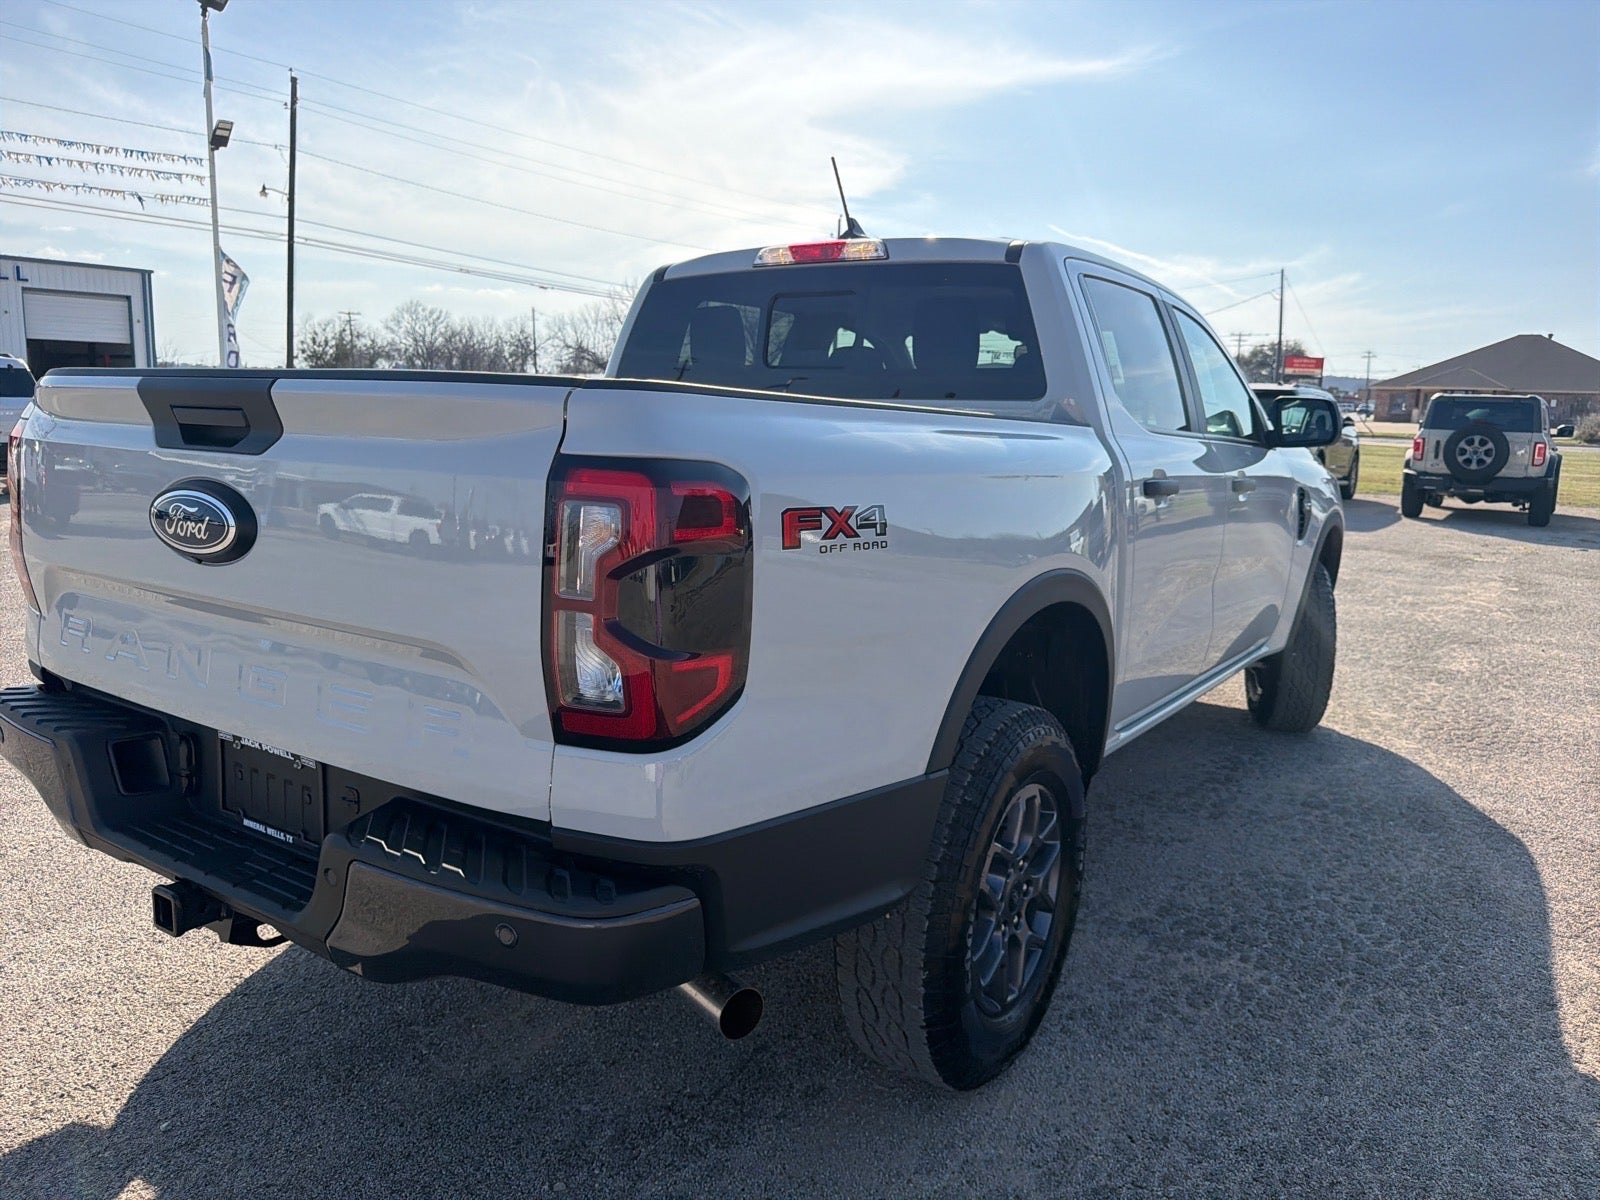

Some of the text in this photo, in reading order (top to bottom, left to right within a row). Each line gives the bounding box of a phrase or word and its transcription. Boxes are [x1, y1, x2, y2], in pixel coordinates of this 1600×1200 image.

[165, 502, 210, 540] Ford
[780, 504, 888, 551] FX4
[819, 540, 888, 554] OFF ROAD
[60, 607, 476, 758] RANGER
[241, 737, 295, 760] JACK POWELL
